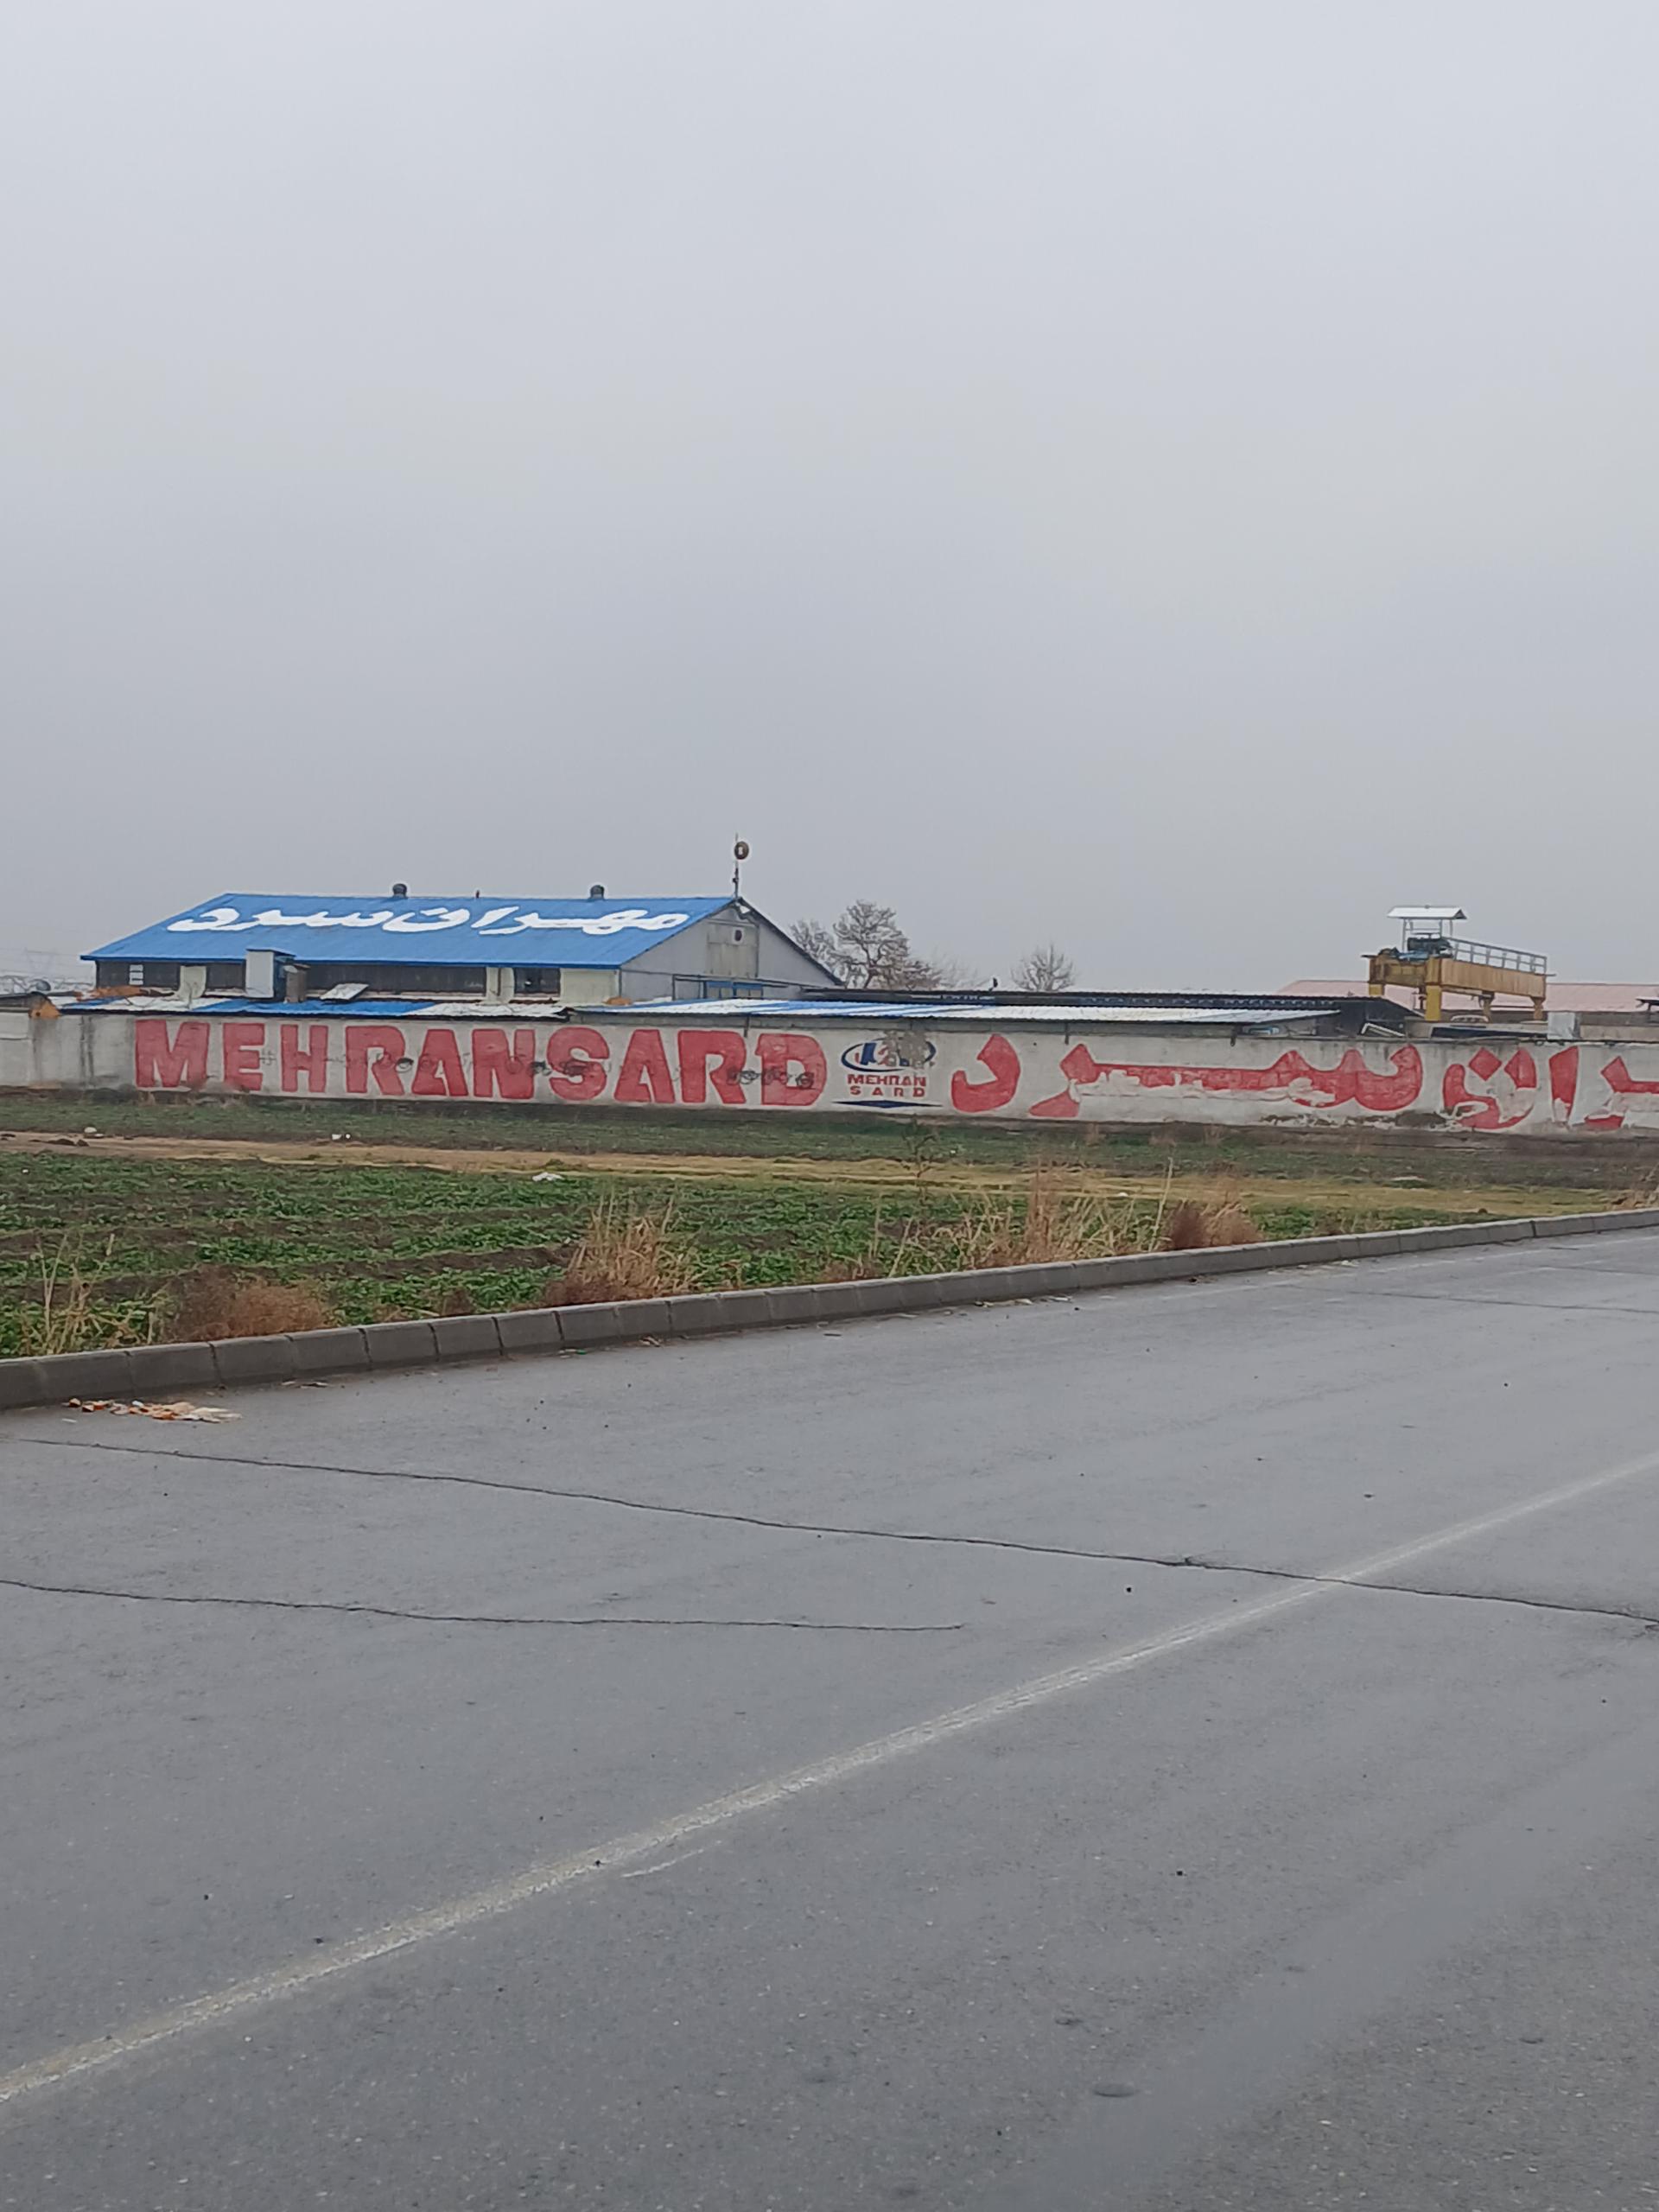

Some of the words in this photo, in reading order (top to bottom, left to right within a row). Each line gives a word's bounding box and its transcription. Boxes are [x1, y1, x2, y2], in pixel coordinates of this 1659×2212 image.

[167, 907, 394, 931] سرد
[383, 906, 690, 935] مهران
[847, 1074, 926, 1087] MEHRAN
[1441, 1044, 1659, 1131] ران
